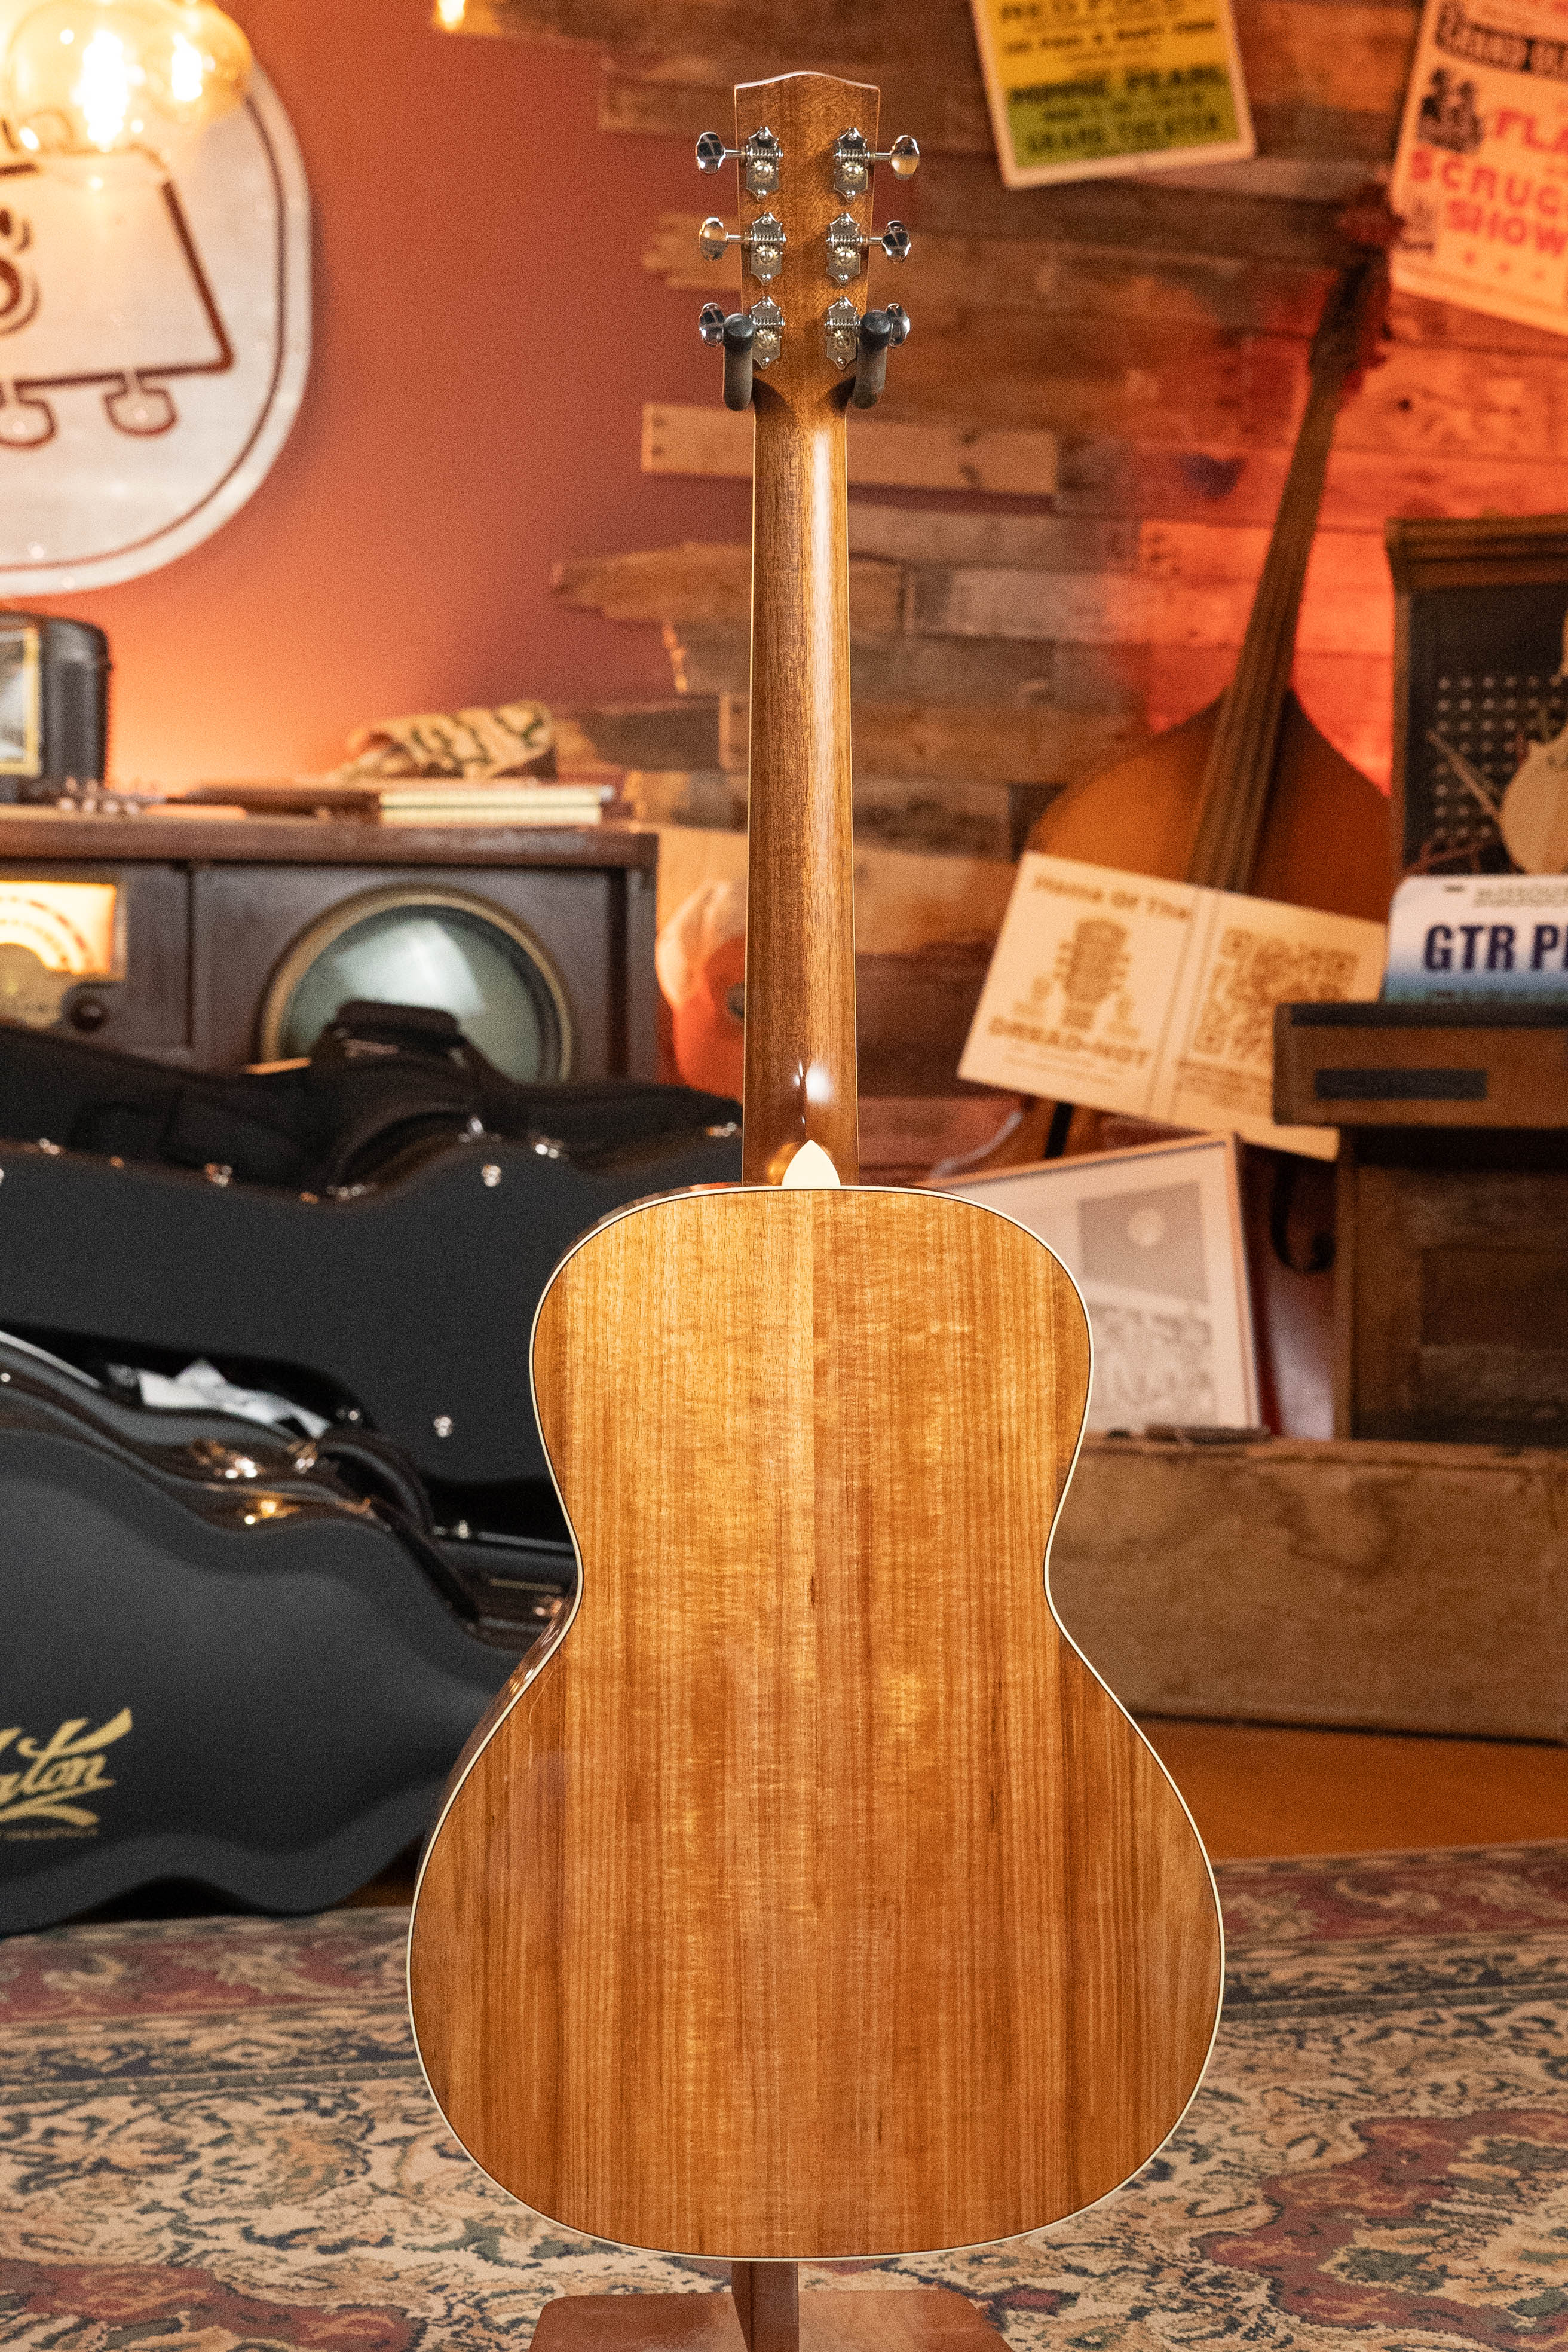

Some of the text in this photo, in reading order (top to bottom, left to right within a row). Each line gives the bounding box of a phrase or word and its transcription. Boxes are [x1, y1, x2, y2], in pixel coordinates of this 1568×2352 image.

[1447, 199, 1568, 256] SHOW
[1424, 924, 1568, 971] GTR P
[989, 1017, 1150, 1068] DREAD-NOT
